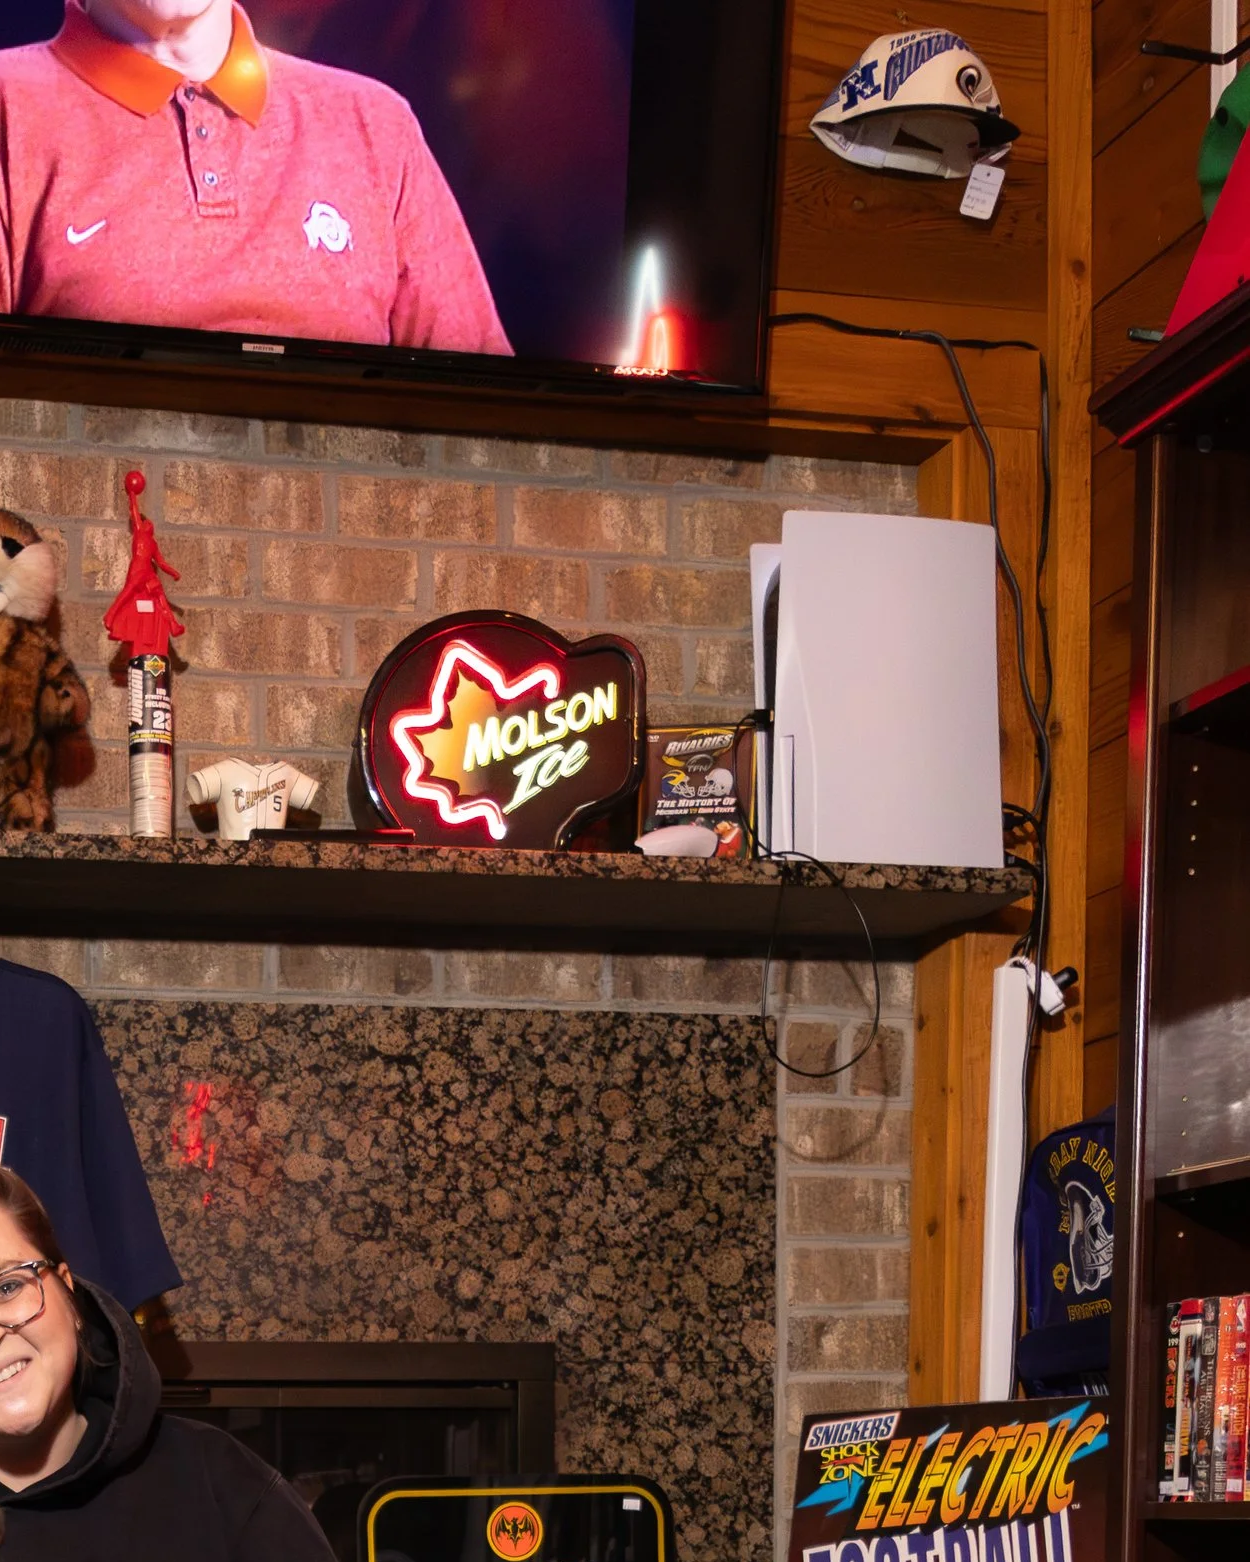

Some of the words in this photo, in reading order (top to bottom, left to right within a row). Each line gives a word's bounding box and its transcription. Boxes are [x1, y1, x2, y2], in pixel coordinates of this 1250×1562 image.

[131, 669, 143, 726] JORDAN
[152, 710, 171, 731] 23
[463, 682, 617, 771] MOLSON
[665, 734, 734, 756] RIVALRIES
[502, 740, 590, 815] Ice
[273, 795, 282, 812] 5
[657, 799, 677, 808] THE
[678, 798, 721, 808] HISTORY
[722, 797, 737, 805] OF
[809, 1415, 897, 1447] SNICKERS
[1233, 1402, 1246, 1436] CLUTCH
[820, 1440, 880, 1461] SHOCK
[819, 1454, 884, 1485] ZONE
[855, 1412, 1107, 1531] ELECTRIC
